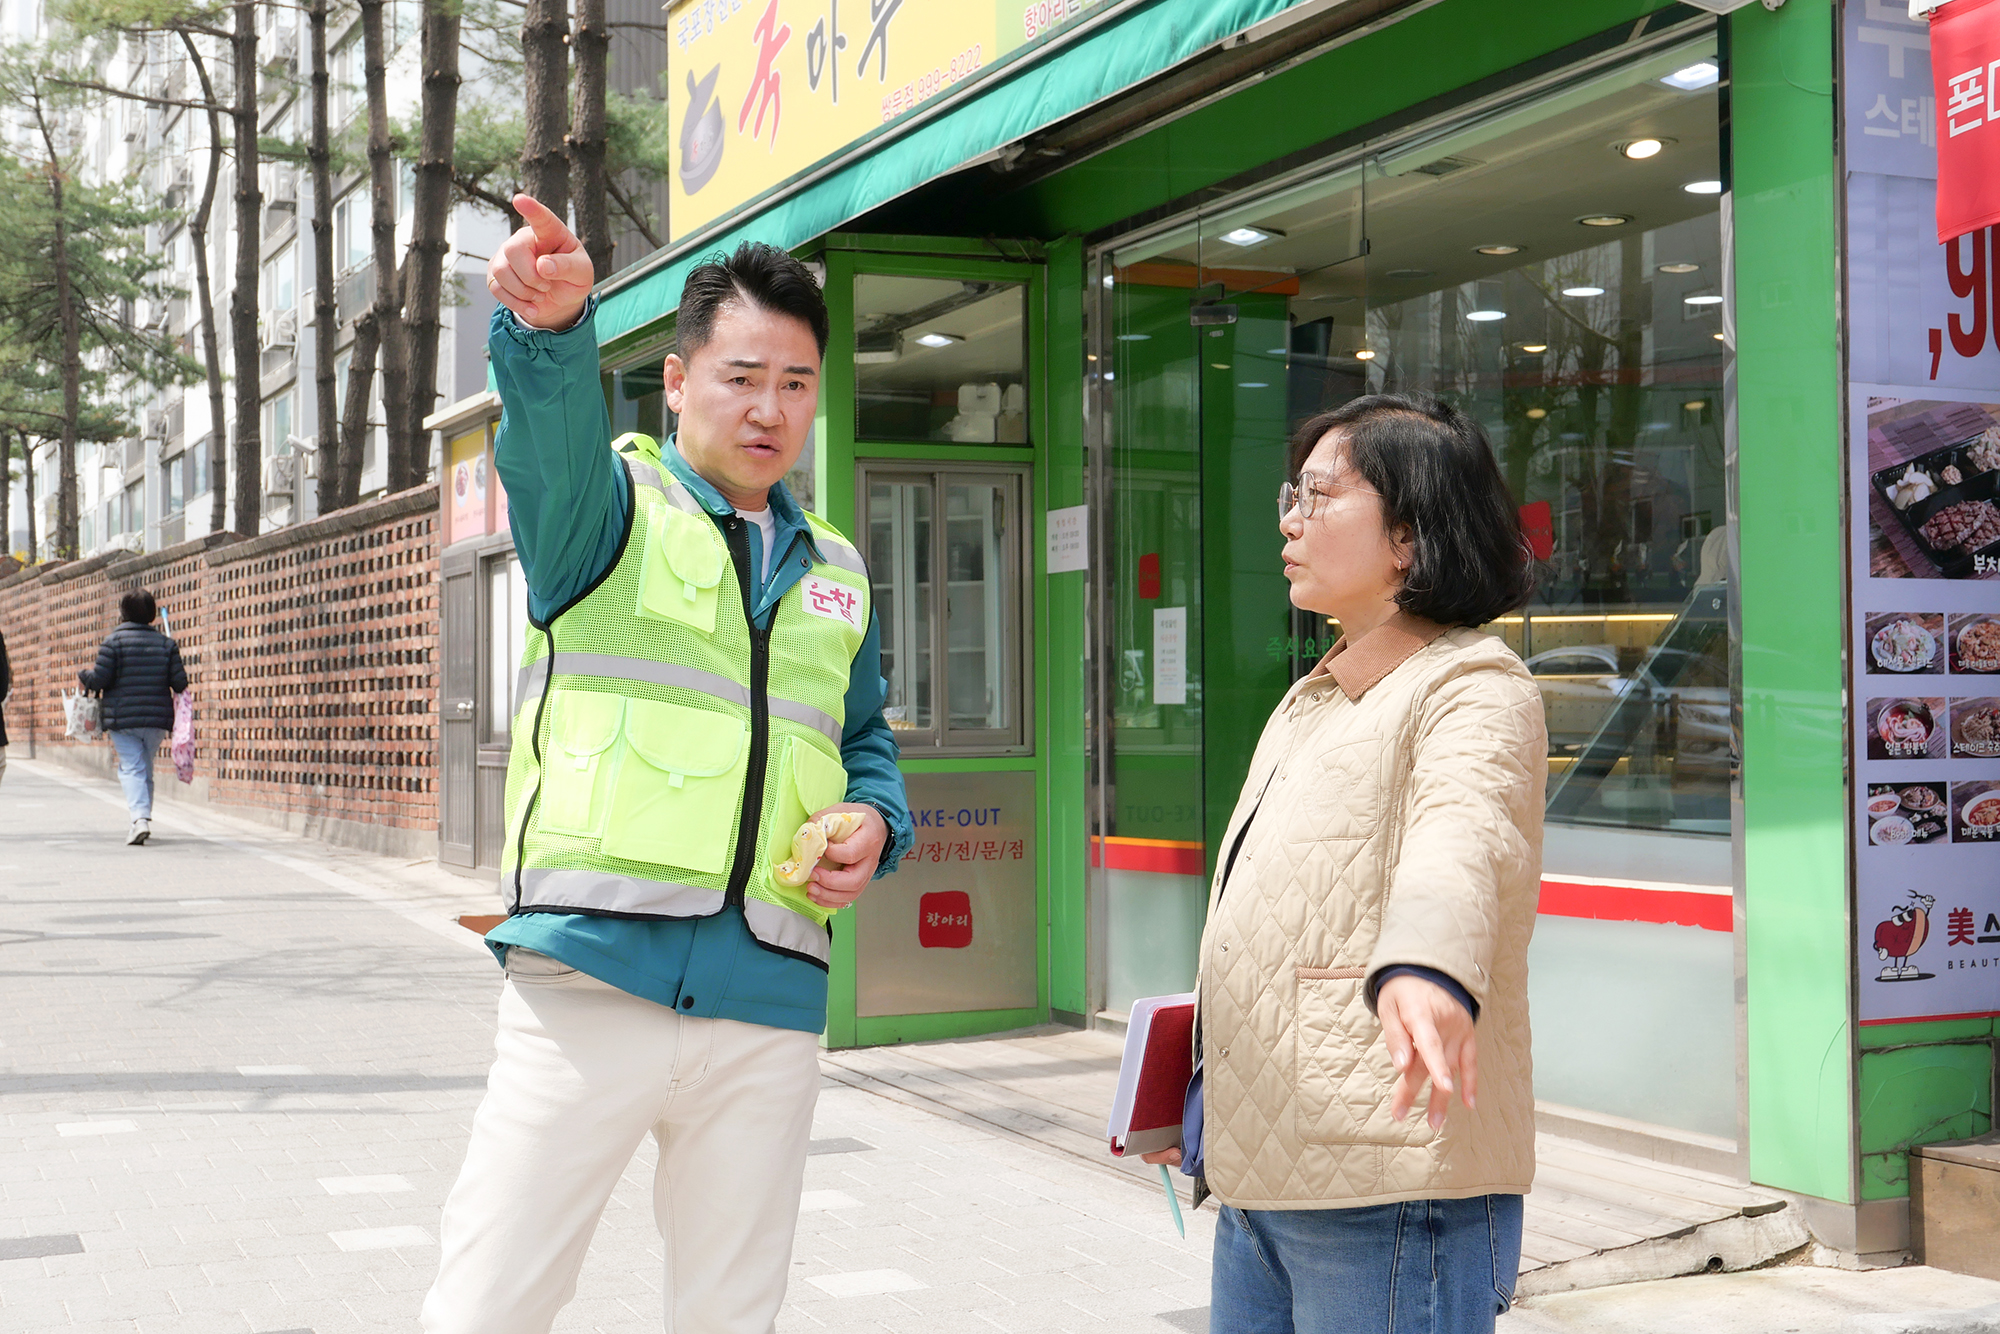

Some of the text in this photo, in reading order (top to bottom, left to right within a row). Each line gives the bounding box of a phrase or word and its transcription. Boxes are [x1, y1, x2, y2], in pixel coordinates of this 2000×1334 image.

[918, 45, 981, 102] 999-8222
[1953, 742, 1985, 753] 스테이크
[926, 912, 968, 927] 항아리
[1948, 958, 2000, 970] BEAUT
